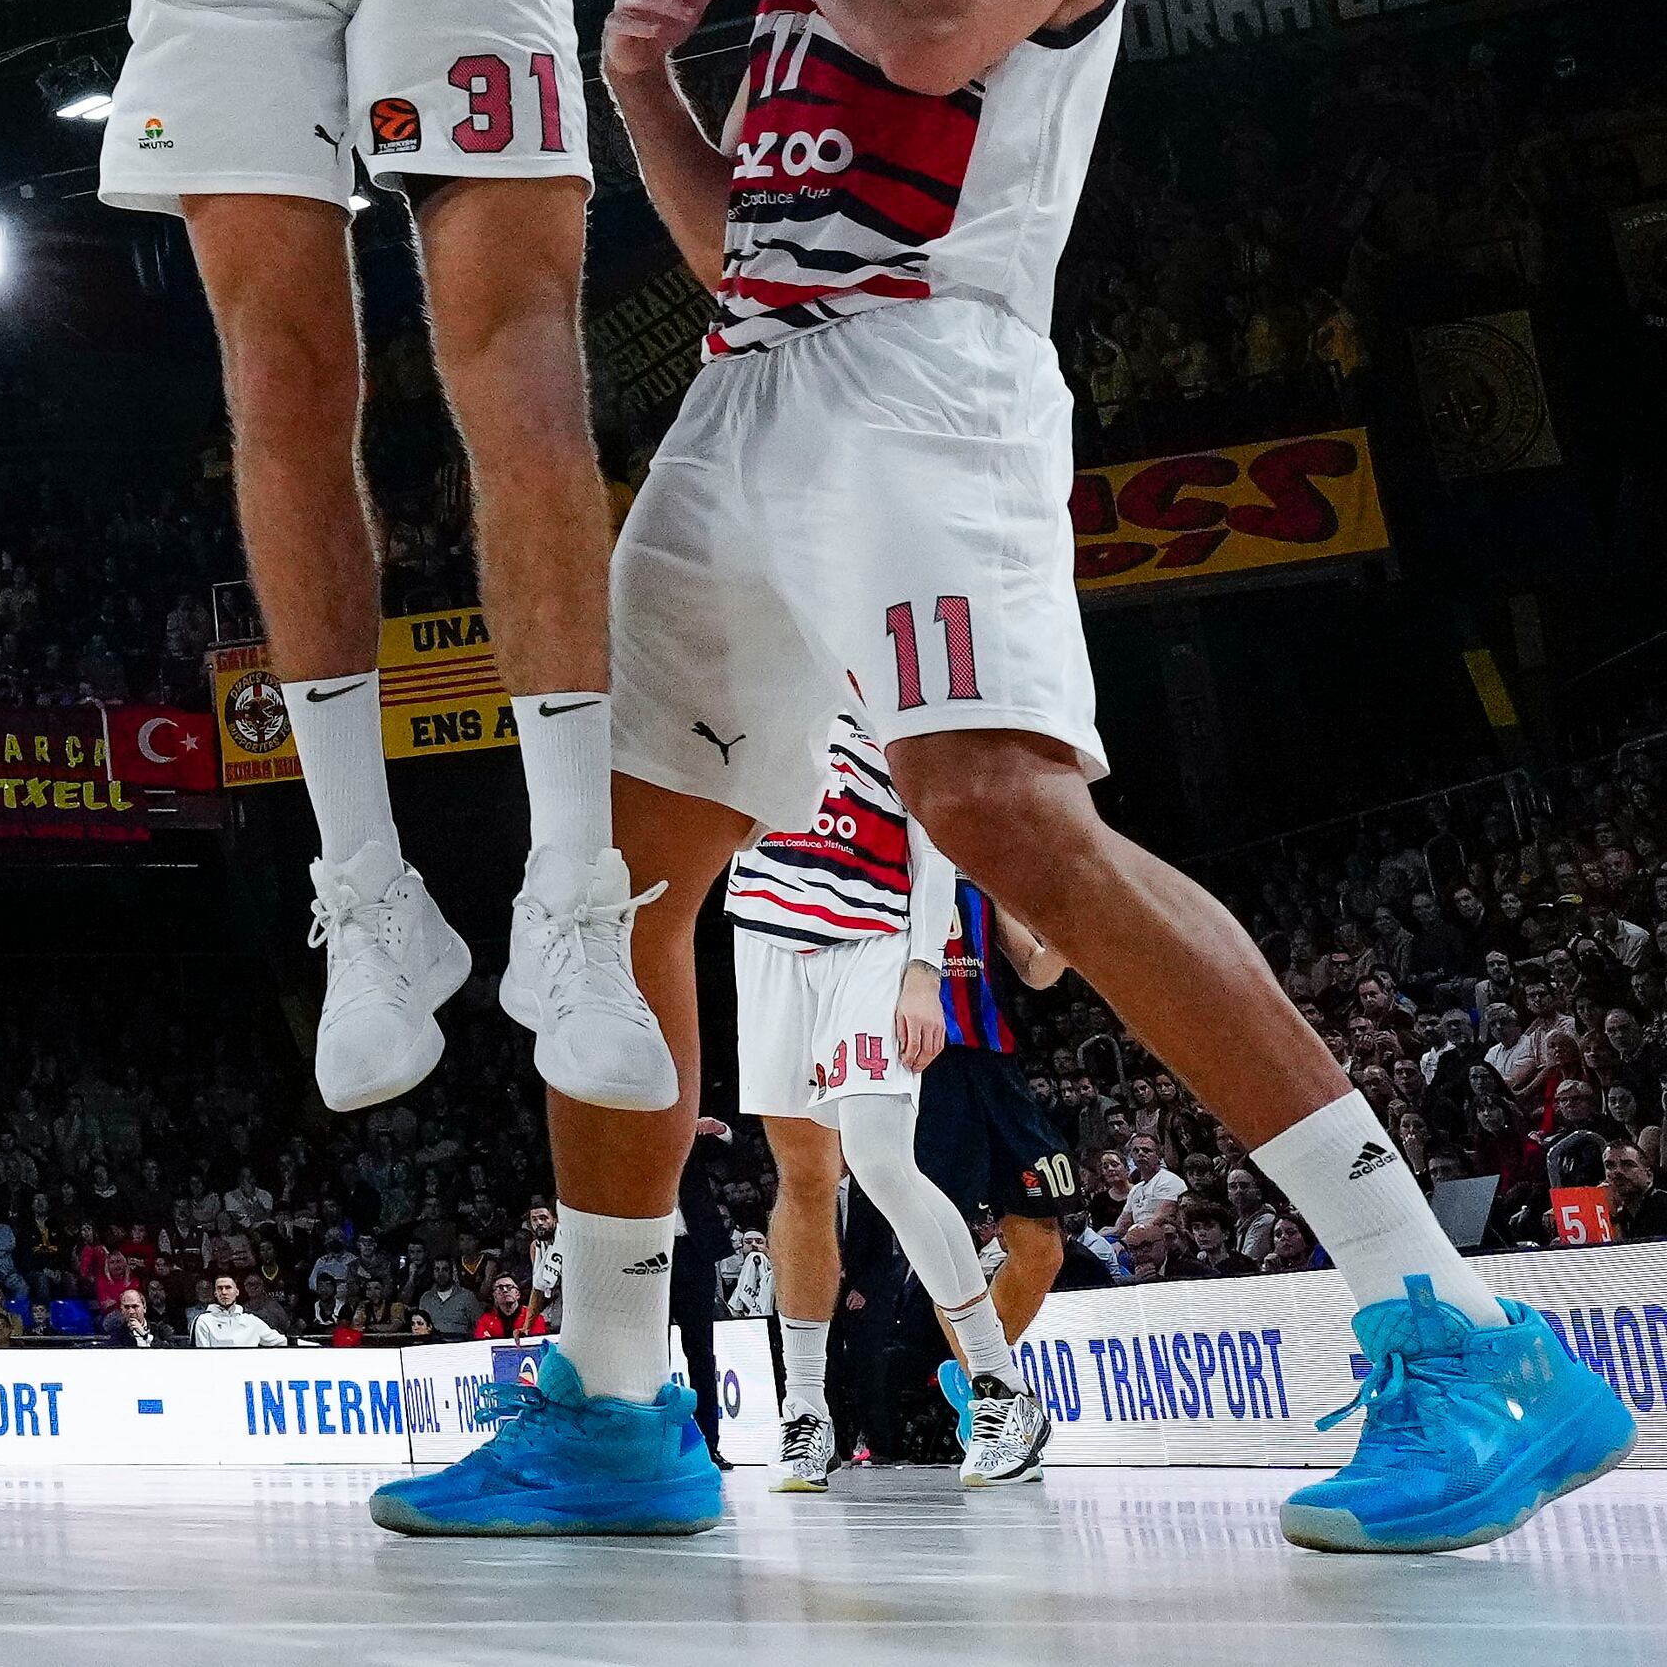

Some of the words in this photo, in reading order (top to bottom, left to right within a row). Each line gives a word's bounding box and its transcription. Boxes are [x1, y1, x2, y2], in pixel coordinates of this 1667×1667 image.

[760, 11, 817, 101] 11
[447, 52, 568, 154] 31
[885, 595, 983, 712] 11
[410, 707, 488, 749] ENS
[828, 1031, 890, 1090] 34
[1034, 1152, 1076, 1199] 10
[1560, 1204, 1588, 1246] 5
[1012, 1338, 1081, 1424] OAD
[1089, 1327, 1292, 1423] TRANSPORT
